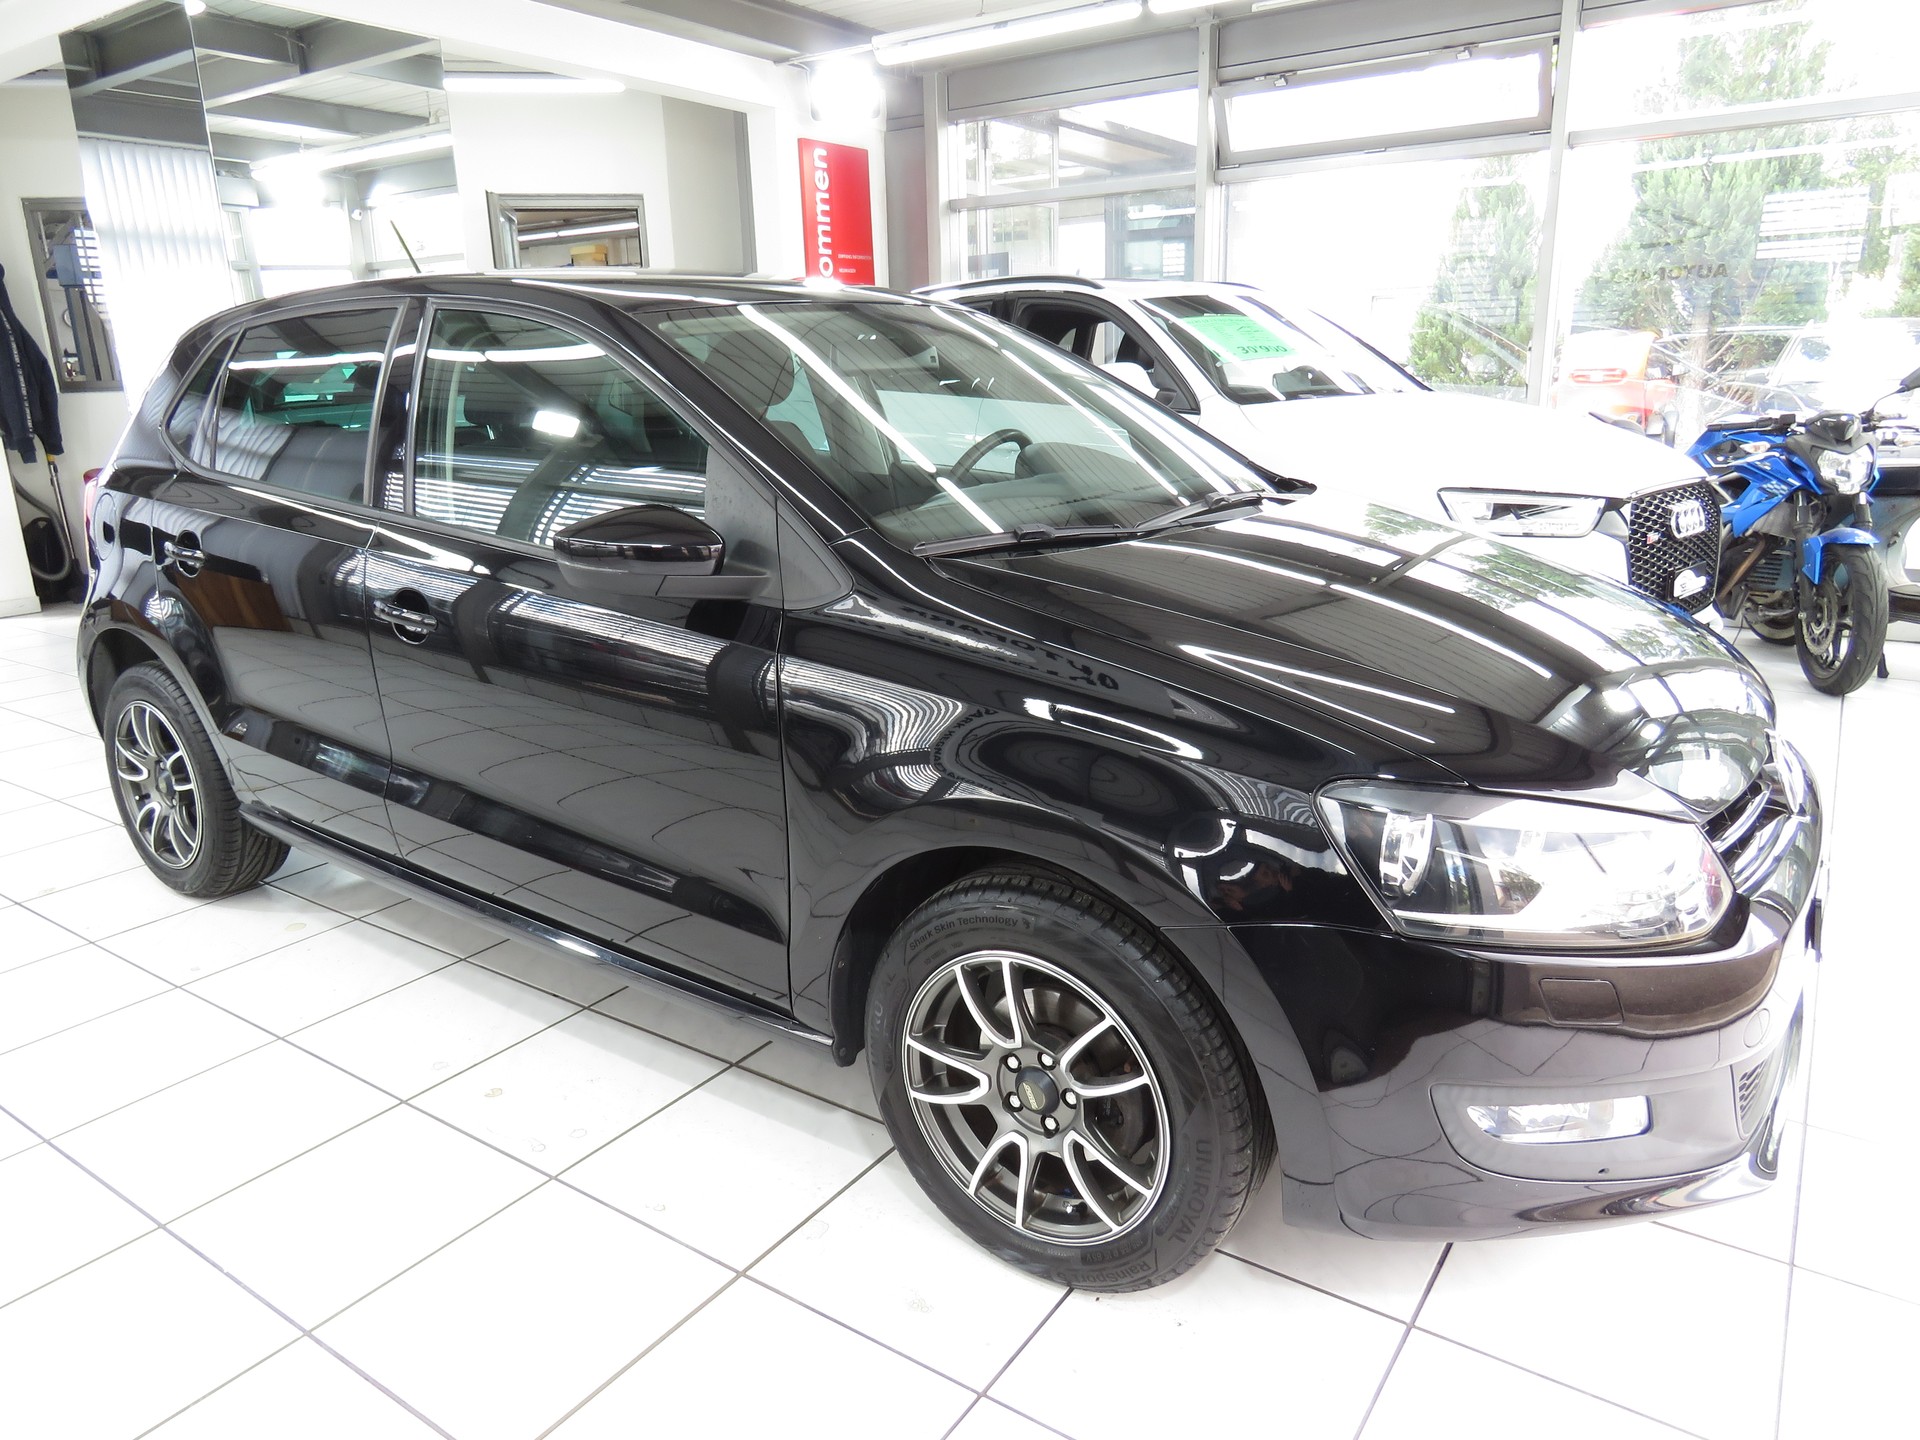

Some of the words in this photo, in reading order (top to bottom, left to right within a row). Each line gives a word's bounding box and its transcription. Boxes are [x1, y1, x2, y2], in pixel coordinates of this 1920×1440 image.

[909, 929, 933, 951] Shark
[934, 920, 956, 934] Skin
[958, 914, 1019, 928] Technology
[1167, 1139, 1212, 1243] UNIROYAL
[1071, 1260, 1152, 1283] RainSport
